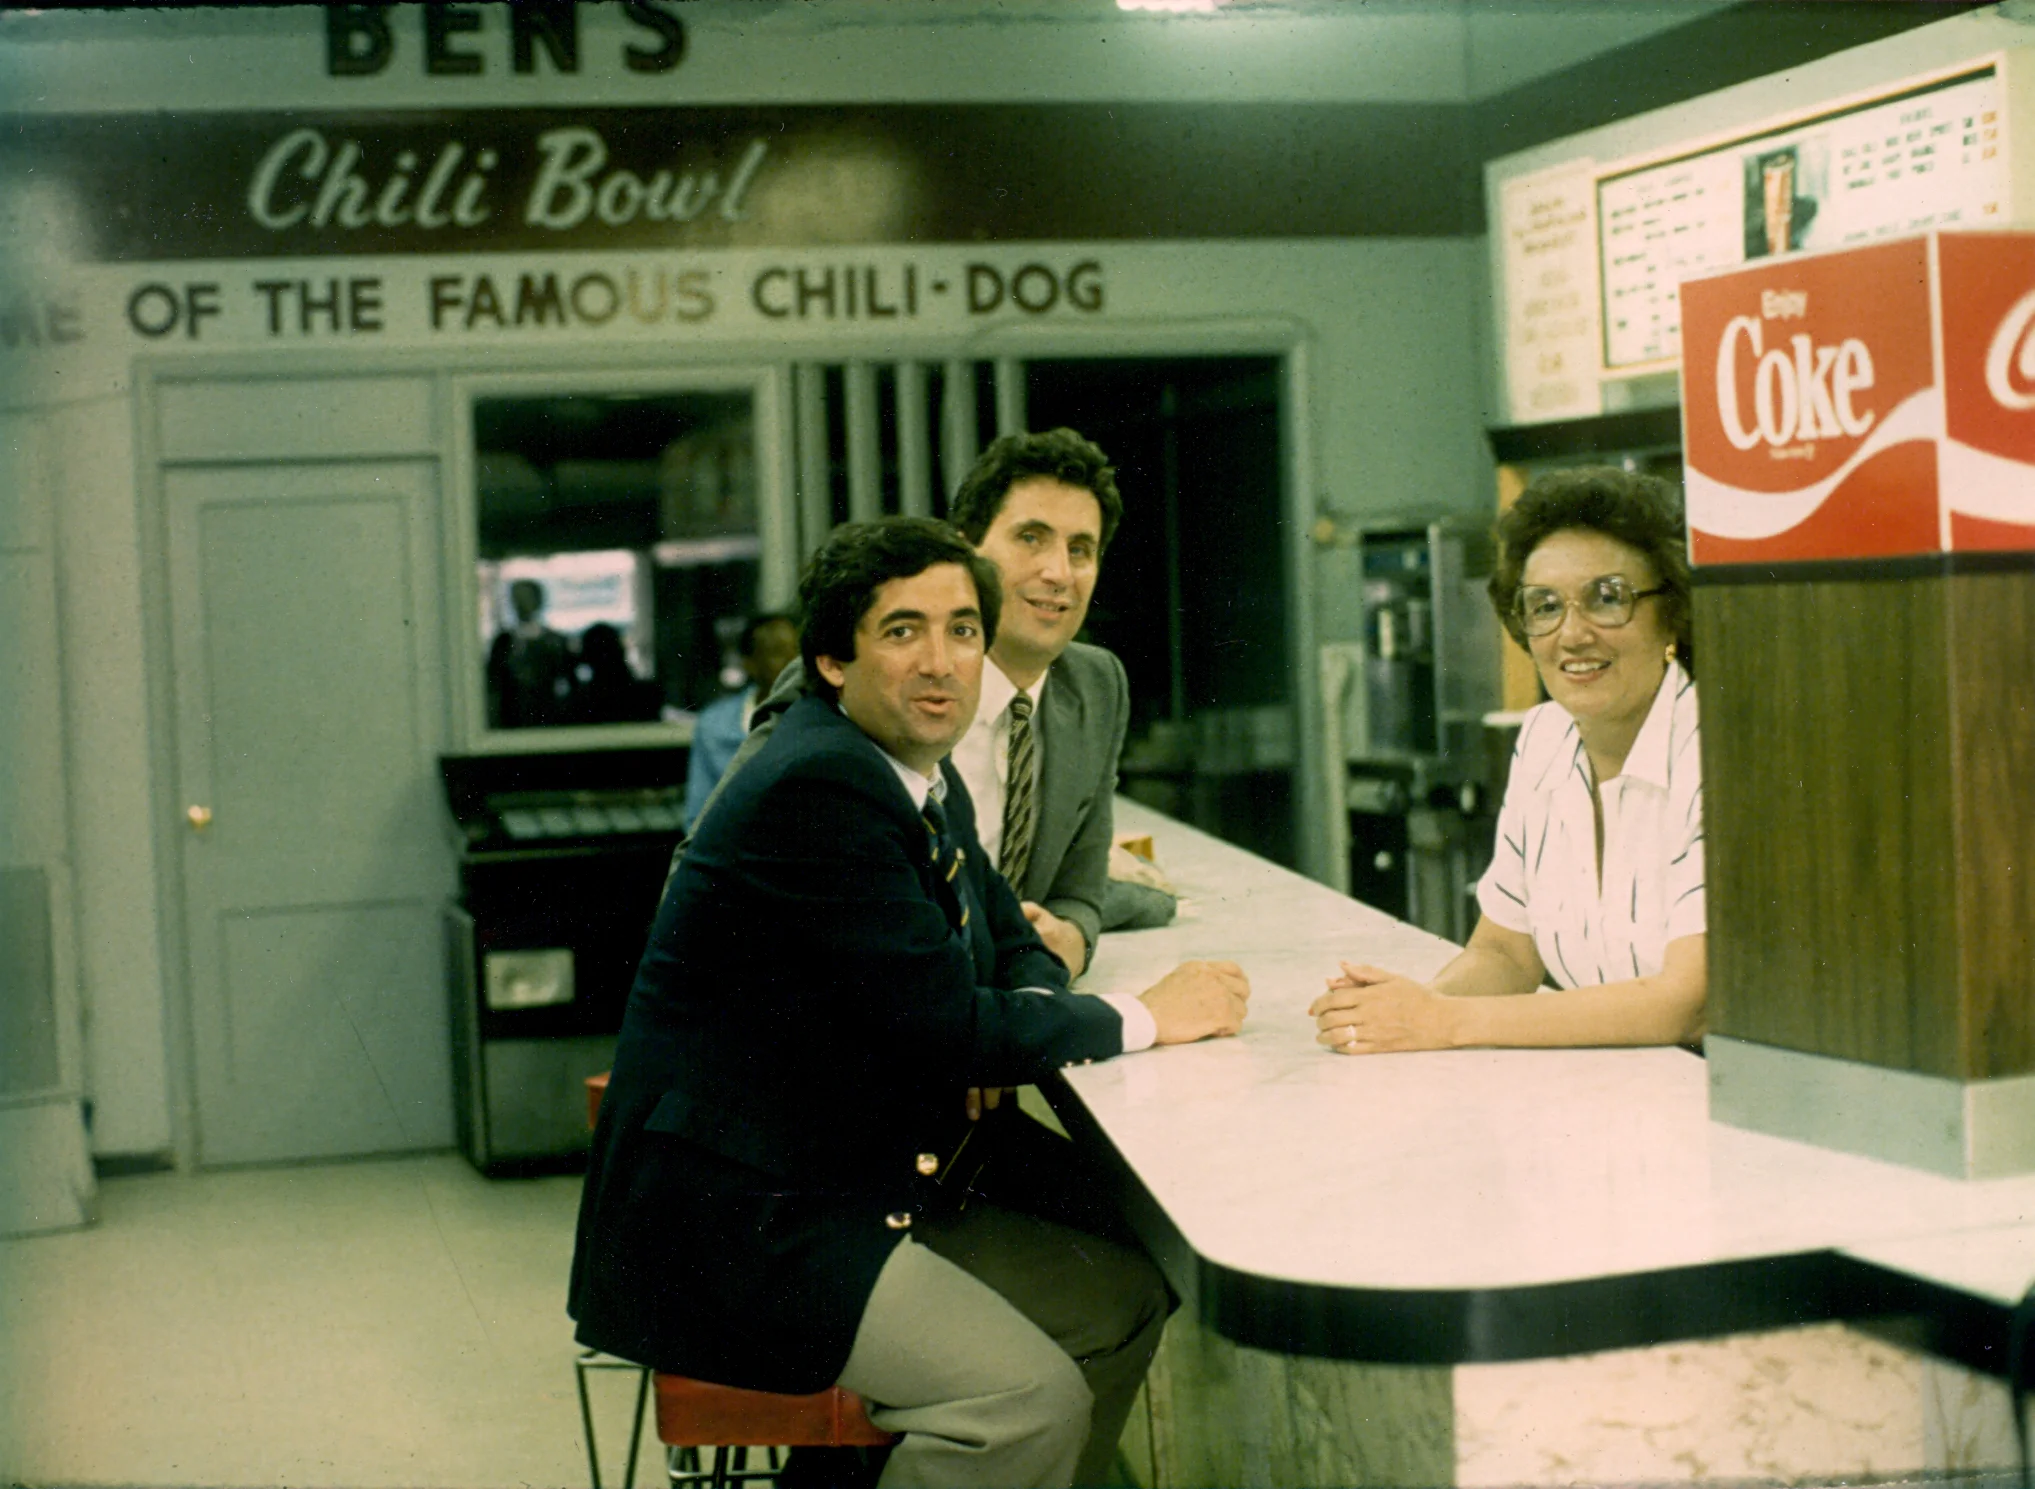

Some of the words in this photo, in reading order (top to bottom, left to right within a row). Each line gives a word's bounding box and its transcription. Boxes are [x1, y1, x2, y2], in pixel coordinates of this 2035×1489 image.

[247, 129, 499, 229] Chili
[525, 126, 767, 229] Bowl
[128, 282, 221, 340] OF
[255, 277, 382, 333] THE
[429, 270, 716, 330] FAMOUS
[1716, 315, 1875, 451] Coke
